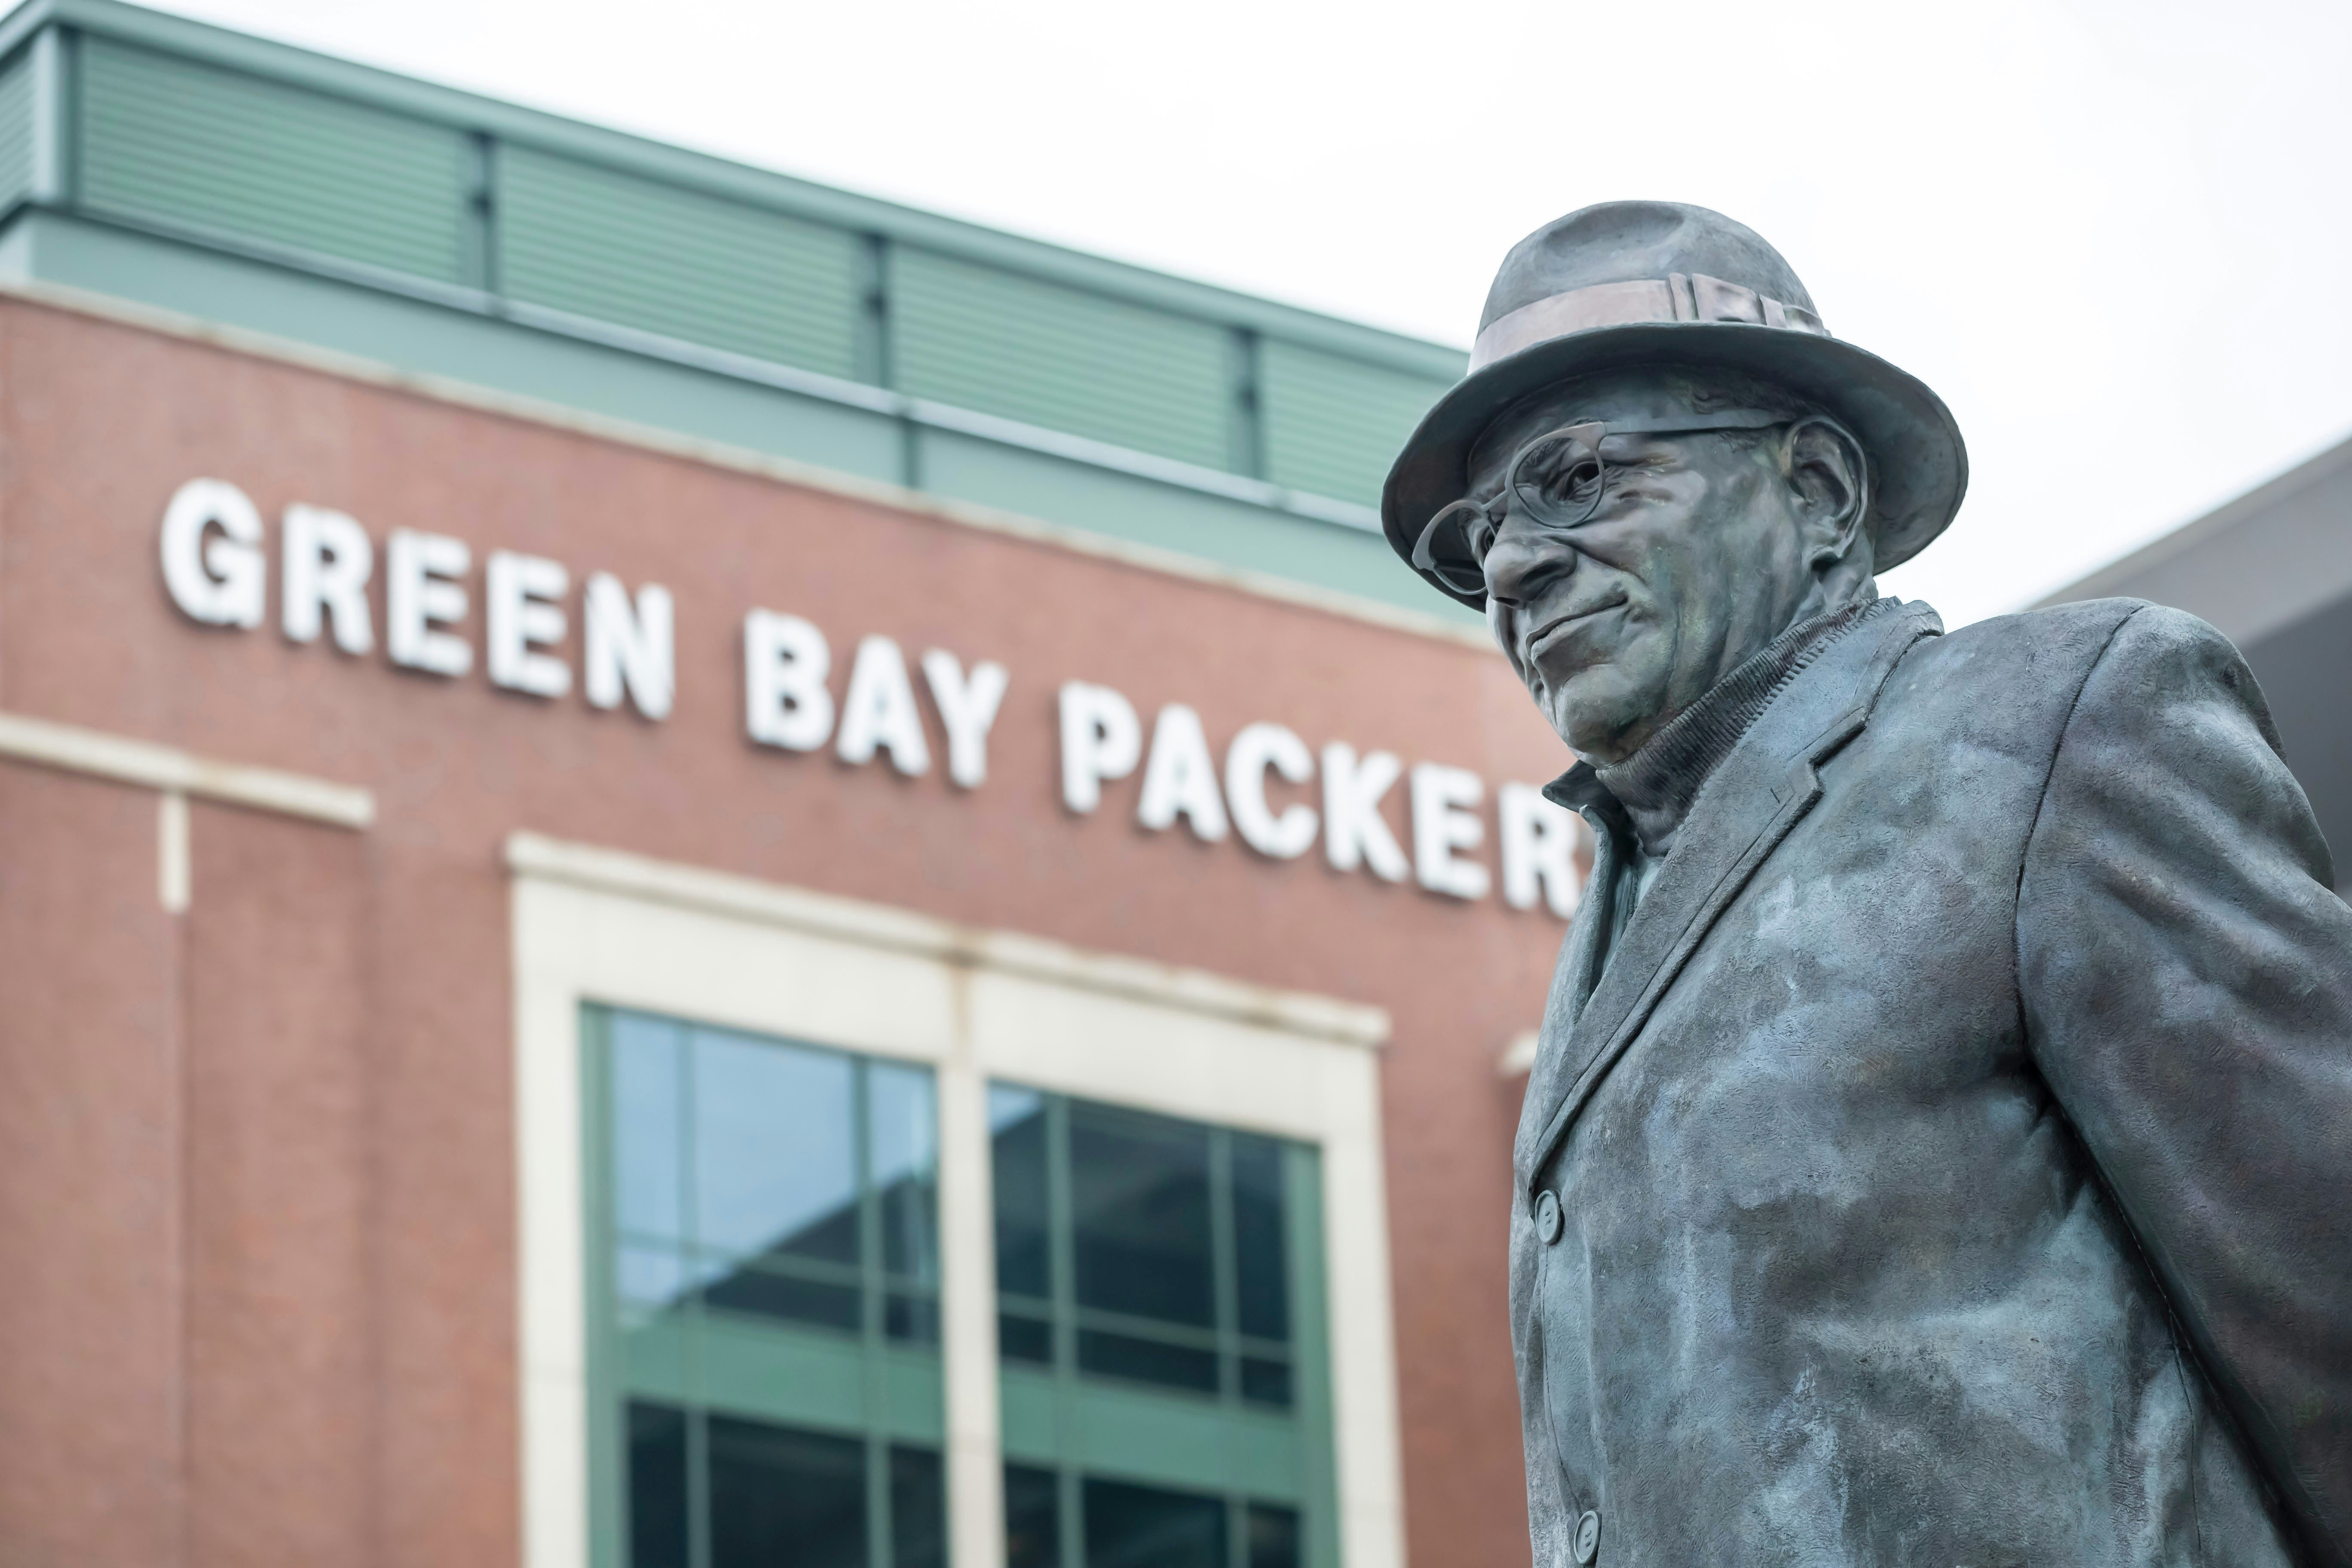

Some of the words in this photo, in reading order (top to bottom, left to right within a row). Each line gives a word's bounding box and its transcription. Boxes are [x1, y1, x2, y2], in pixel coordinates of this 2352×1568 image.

[160, 476, 677, 722] GREEN
[744, 606, 1009, 789] BAY
[1058, 679, 1584, 920] PACKER
